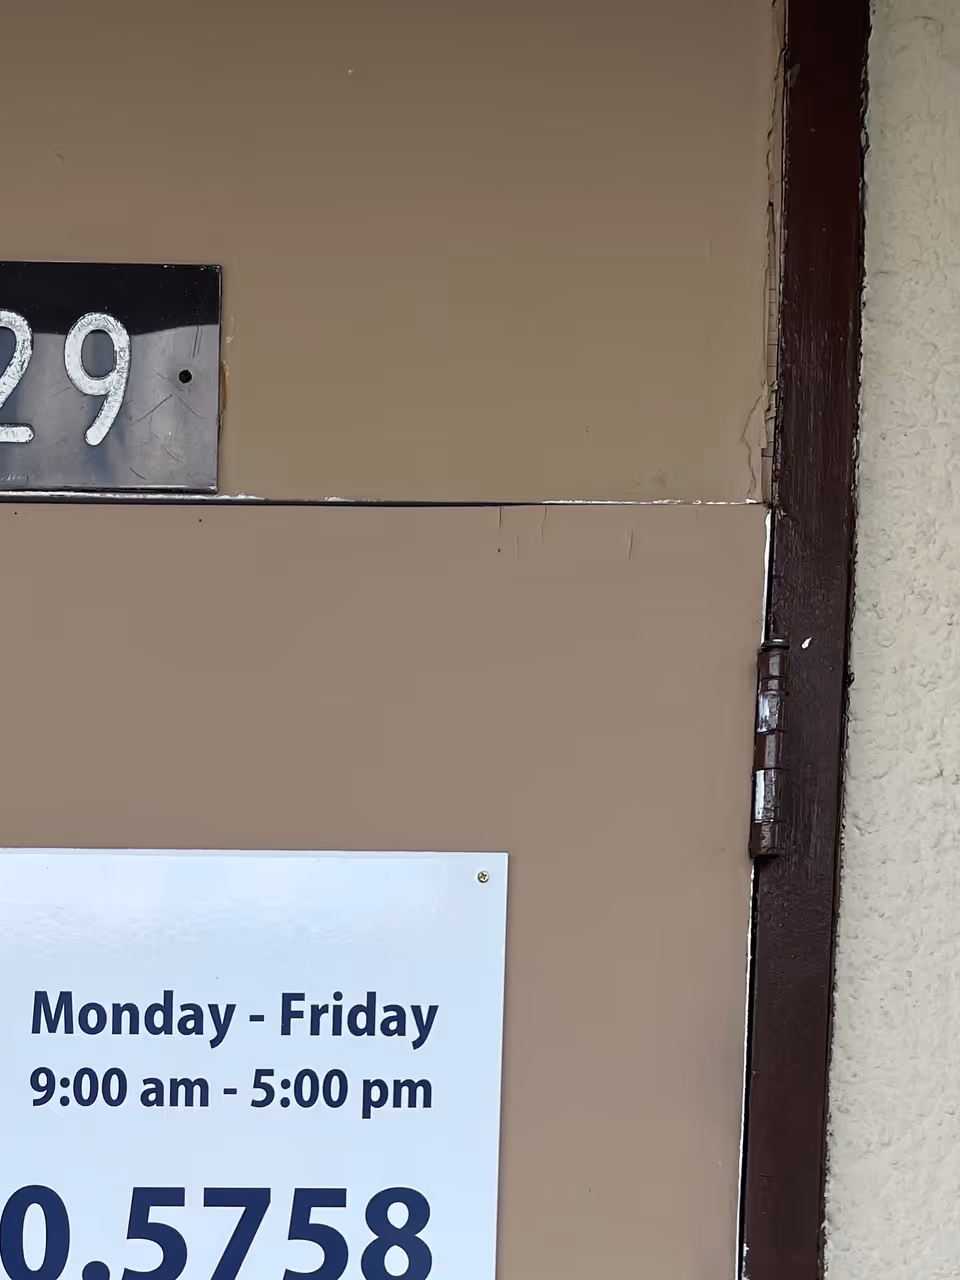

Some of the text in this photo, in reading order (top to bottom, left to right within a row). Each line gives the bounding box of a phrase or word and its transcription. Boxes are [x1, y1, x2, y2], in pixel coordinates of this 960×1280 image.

[31, 989, 439, 1050] Monday - Friday
[29, 1066, 433, 1119] 9:00 am - 5:00 pm
